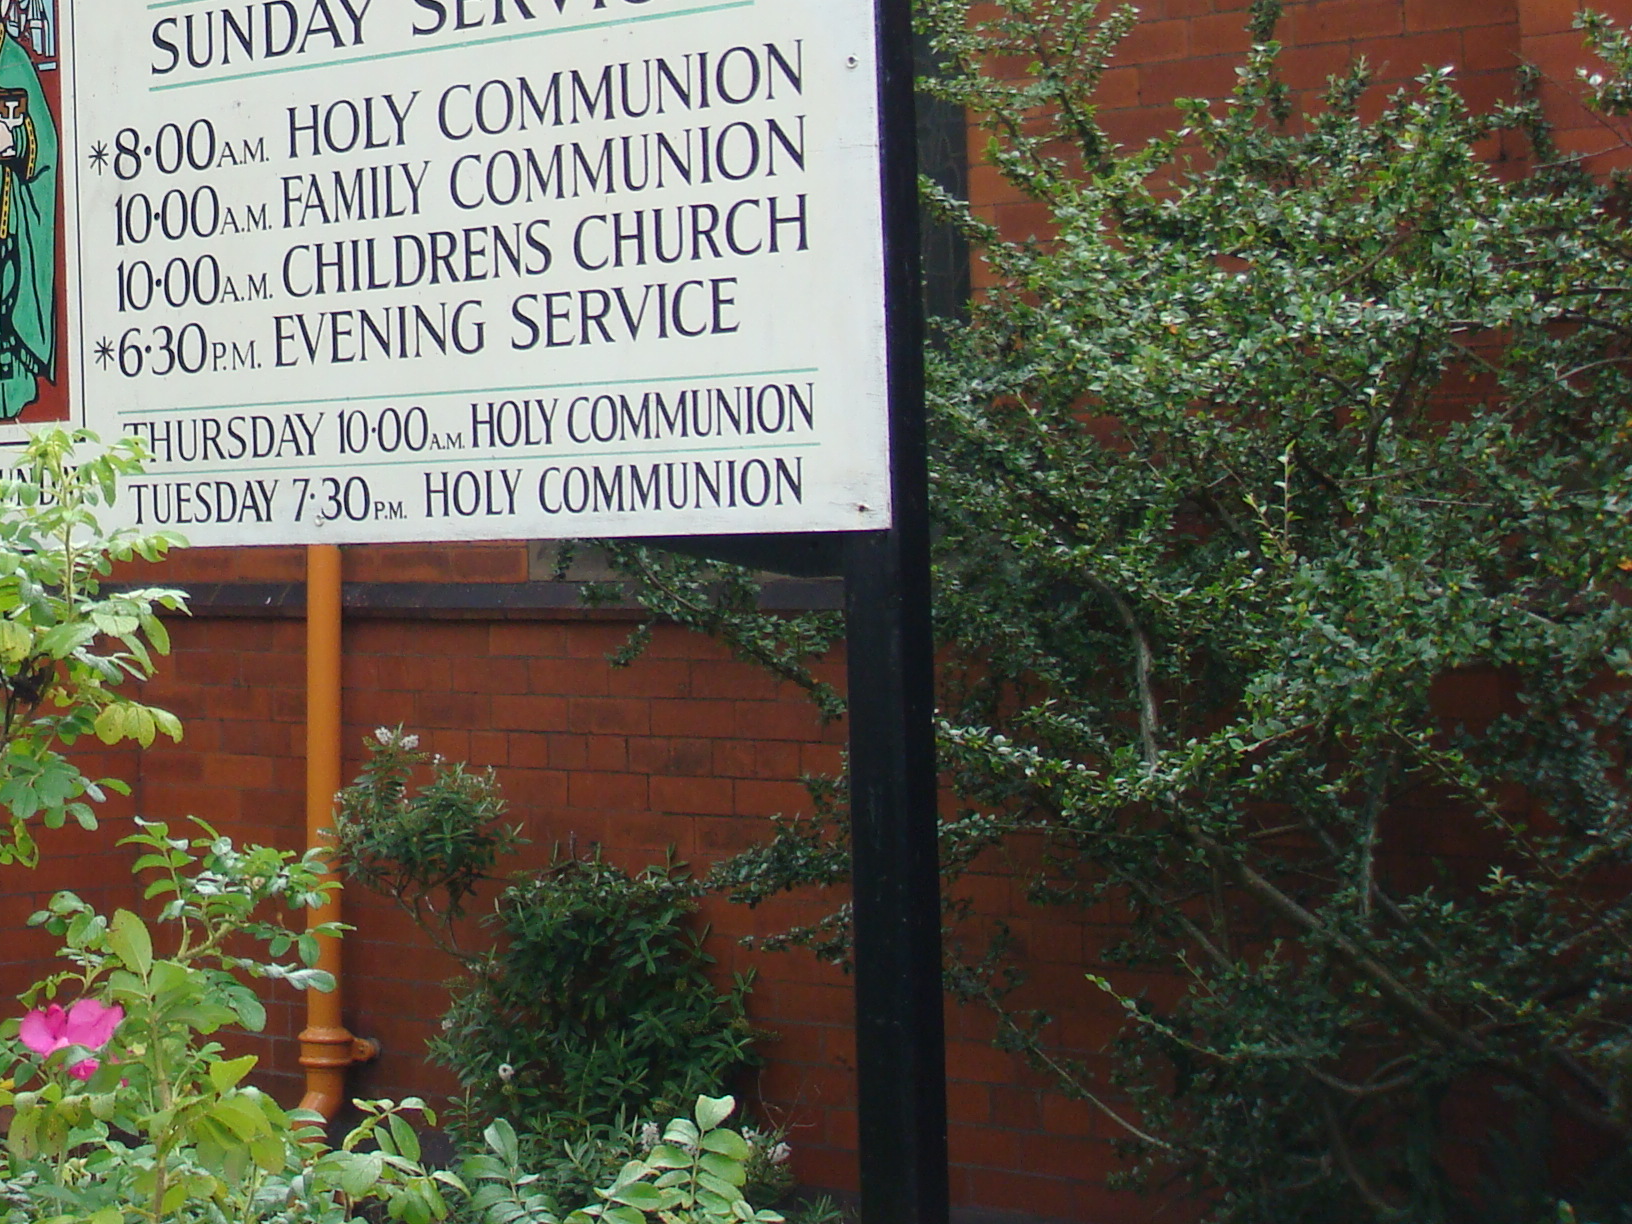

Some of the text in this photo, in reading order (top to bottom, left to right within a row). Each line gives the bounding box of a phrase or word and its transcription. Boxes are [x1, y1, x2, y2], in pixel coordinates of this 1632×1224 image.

[286, 91, 421, 159] HOLY
[438, 39, 803, 141] COMMUNION
[280, 160, 431, 228] FAMILY
[450, 115, 806, 209] COMMUNION
[282, 219, 552, 298] CHILDRENS
[574, 193, 809, 271] CHURCH
[273, 300, 486, 368] EVENING
[510, 277, 740, 350] SERVICE
[123, 412, 325, 463] THURSDAY
[471, 398, 559, 449] HOLY
[567, 383, 814, 443] COMMUNION
[128, 479, 278, 525] TUESDAY
[423, 468, 523, 518] HOLY
[538, 457, 803, 514] COMMUNION
